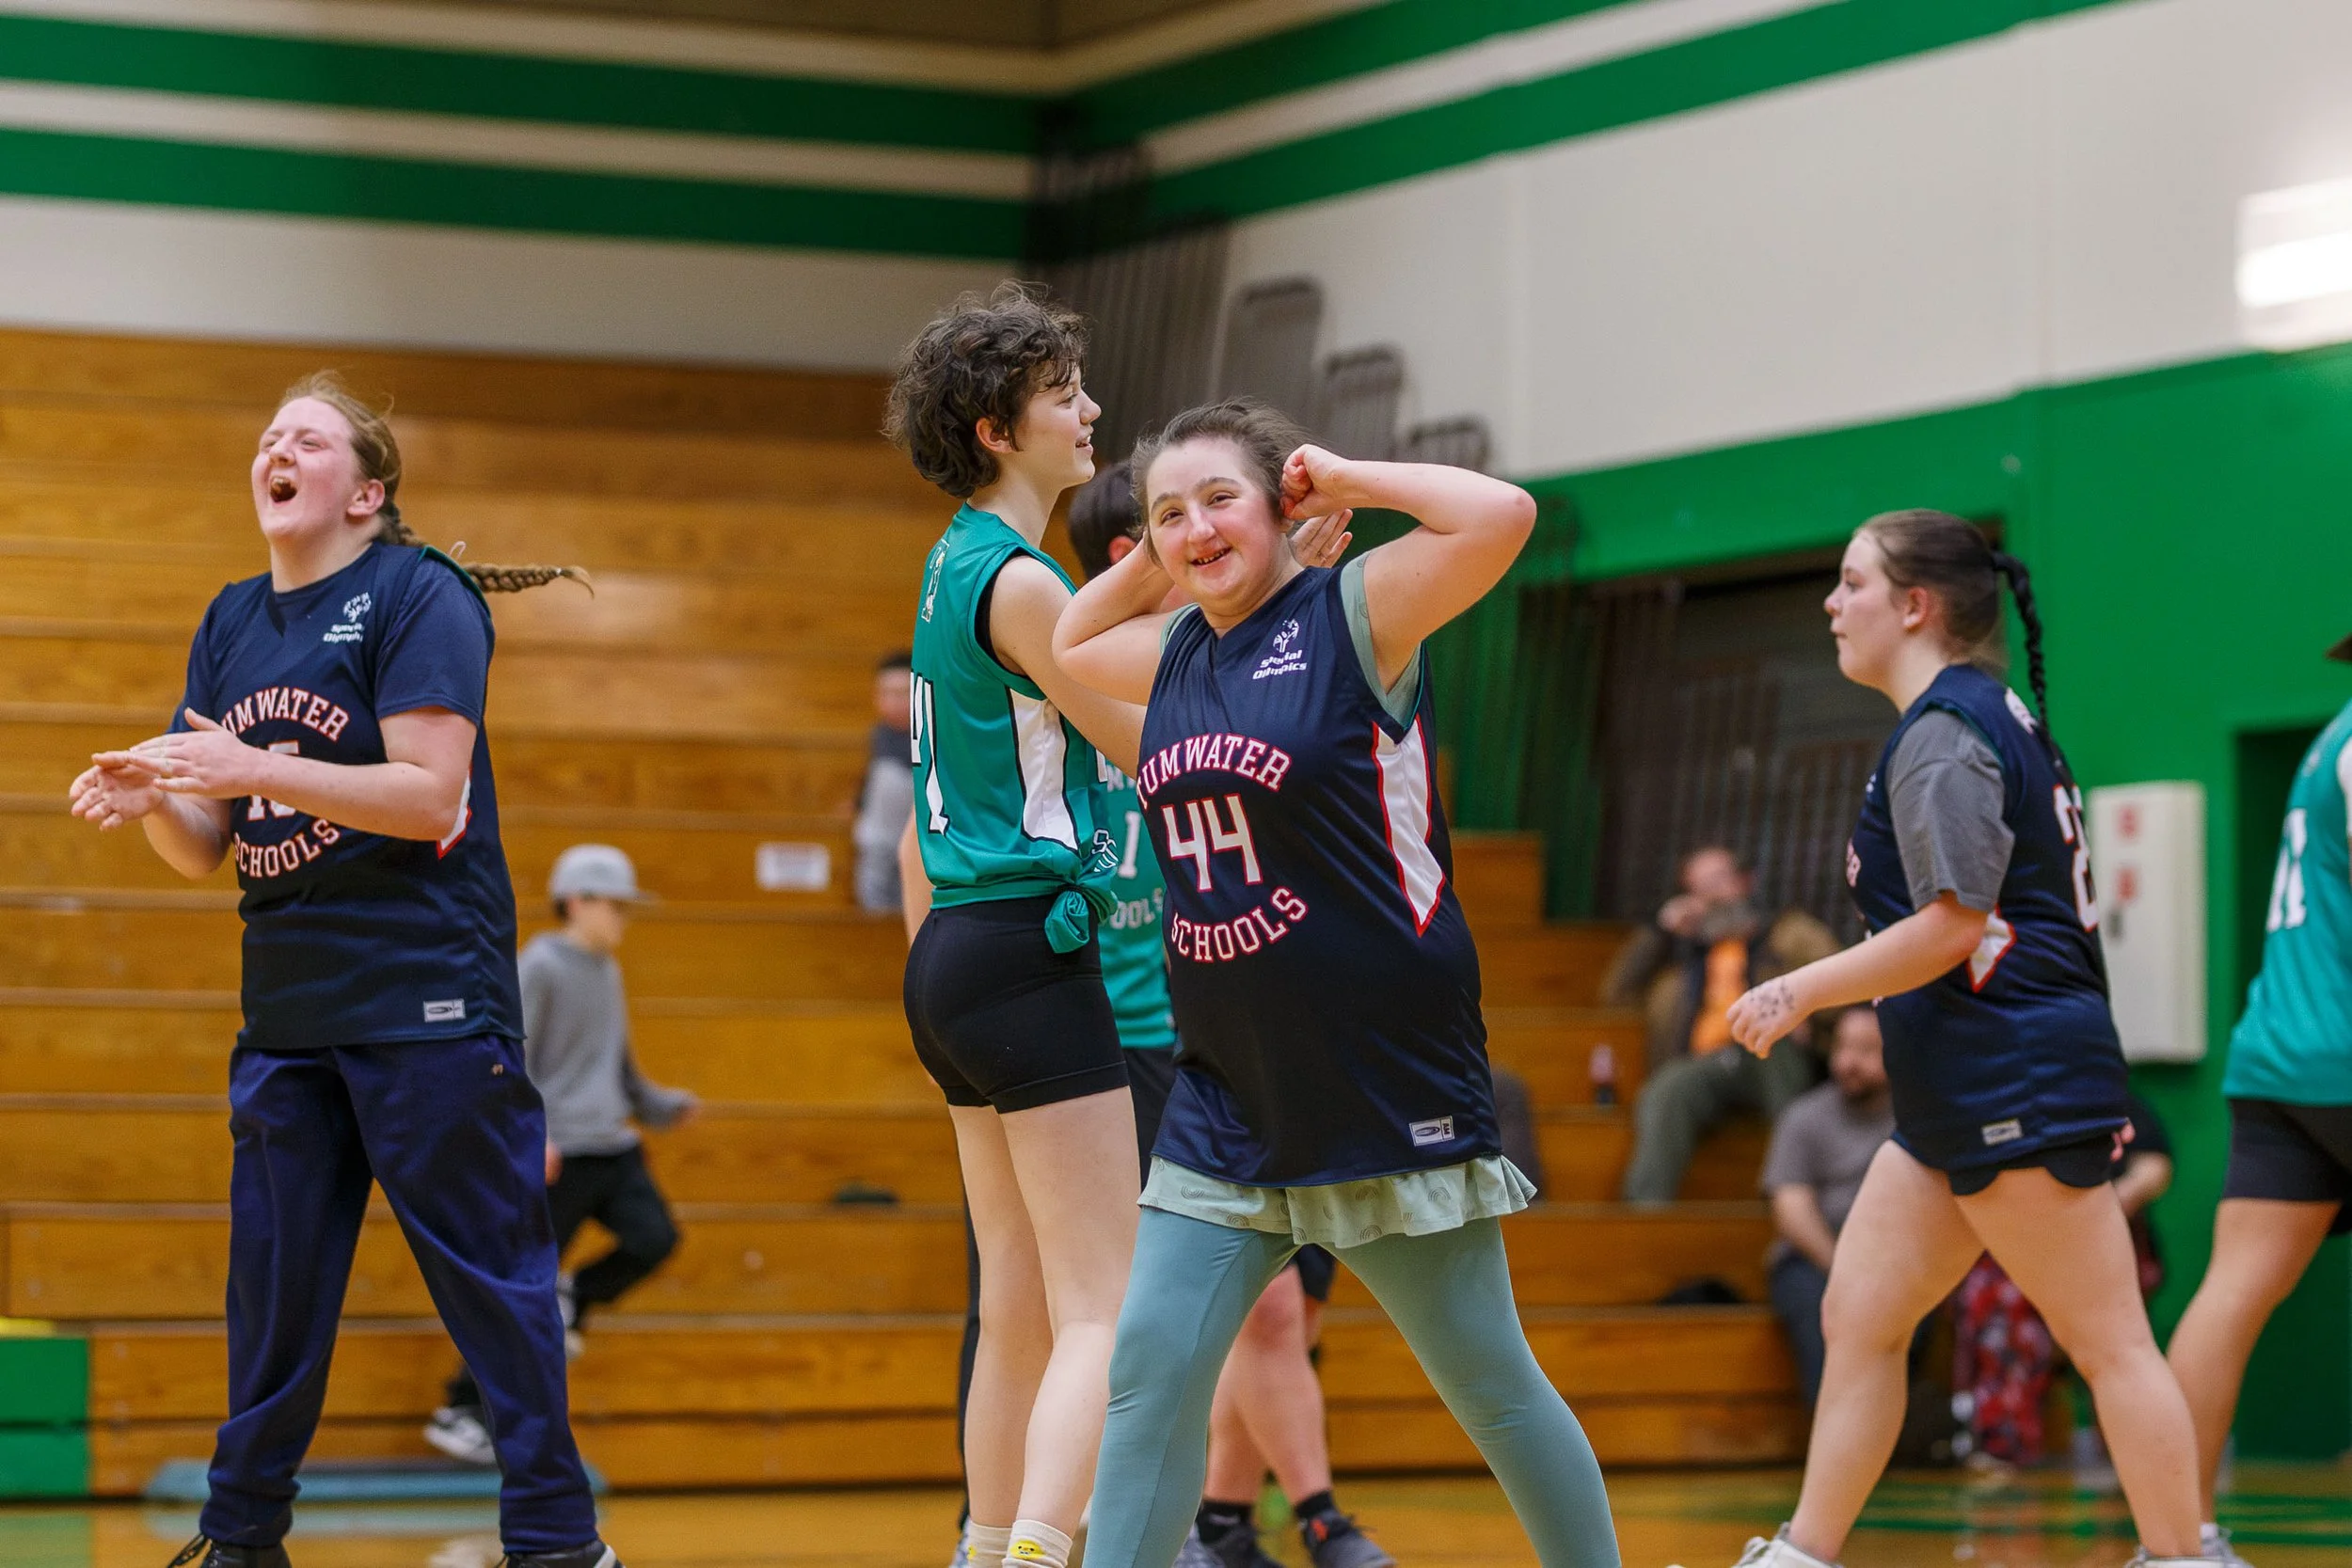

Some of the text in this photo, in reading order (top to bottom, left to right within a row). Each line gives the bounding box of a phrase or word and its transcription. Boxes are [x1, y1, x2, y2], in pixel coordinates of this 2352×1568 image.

[220, 686, 351, 742] UMWATER
[1136, 733, 1293, 810] TUMWATER
[1161, 793, 1263, 893] 44
[1109, 887, 1165, 930] OOLS
[1171, 886, 1309, 963] SCHOOLS
